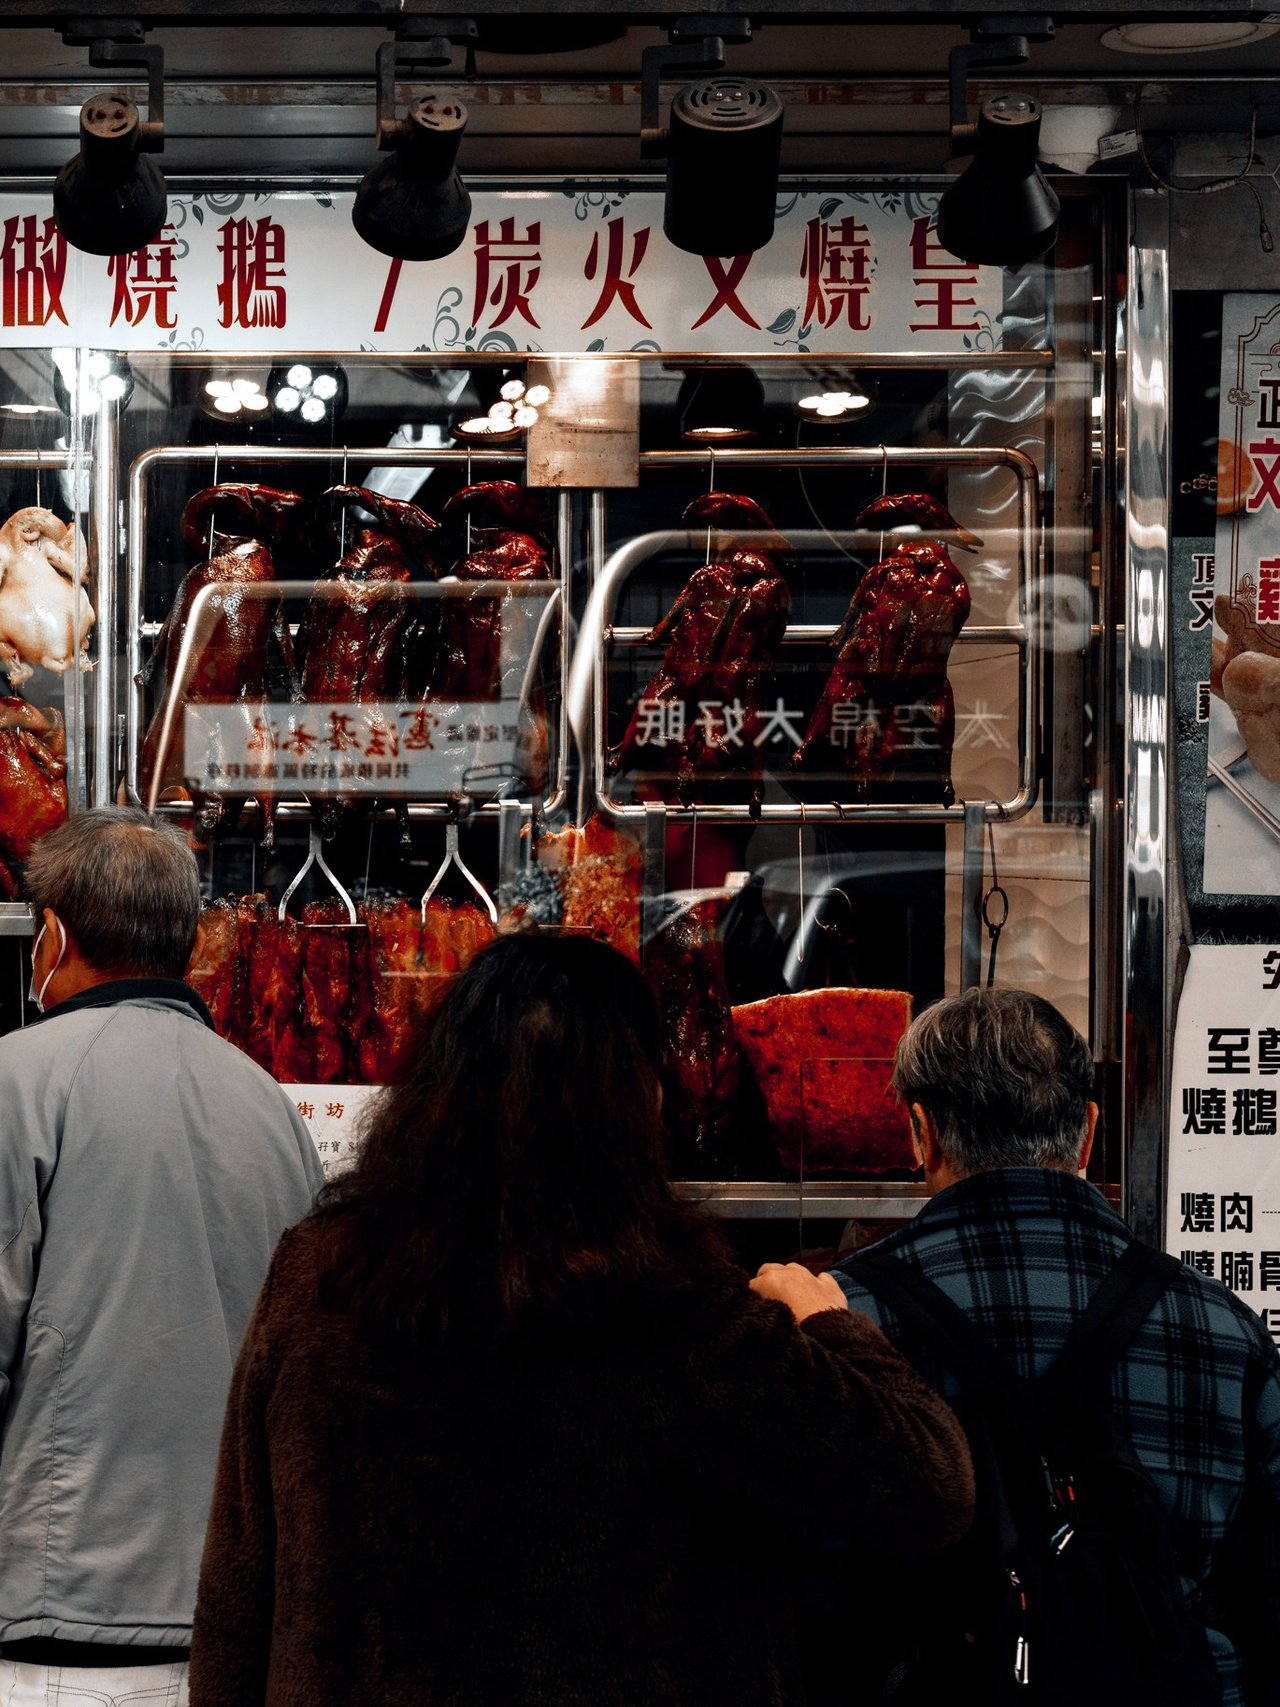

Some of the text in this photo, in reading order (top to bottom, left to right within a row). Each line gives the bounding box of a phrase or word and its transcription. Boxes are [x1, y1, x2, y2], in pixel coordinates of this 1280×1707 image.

[297, 1101, 345, 1120] 街坊
[1182, 1087, 1277, 1136] 燒鵝
[1180, 1192, 1254, 1233] 燒肉
